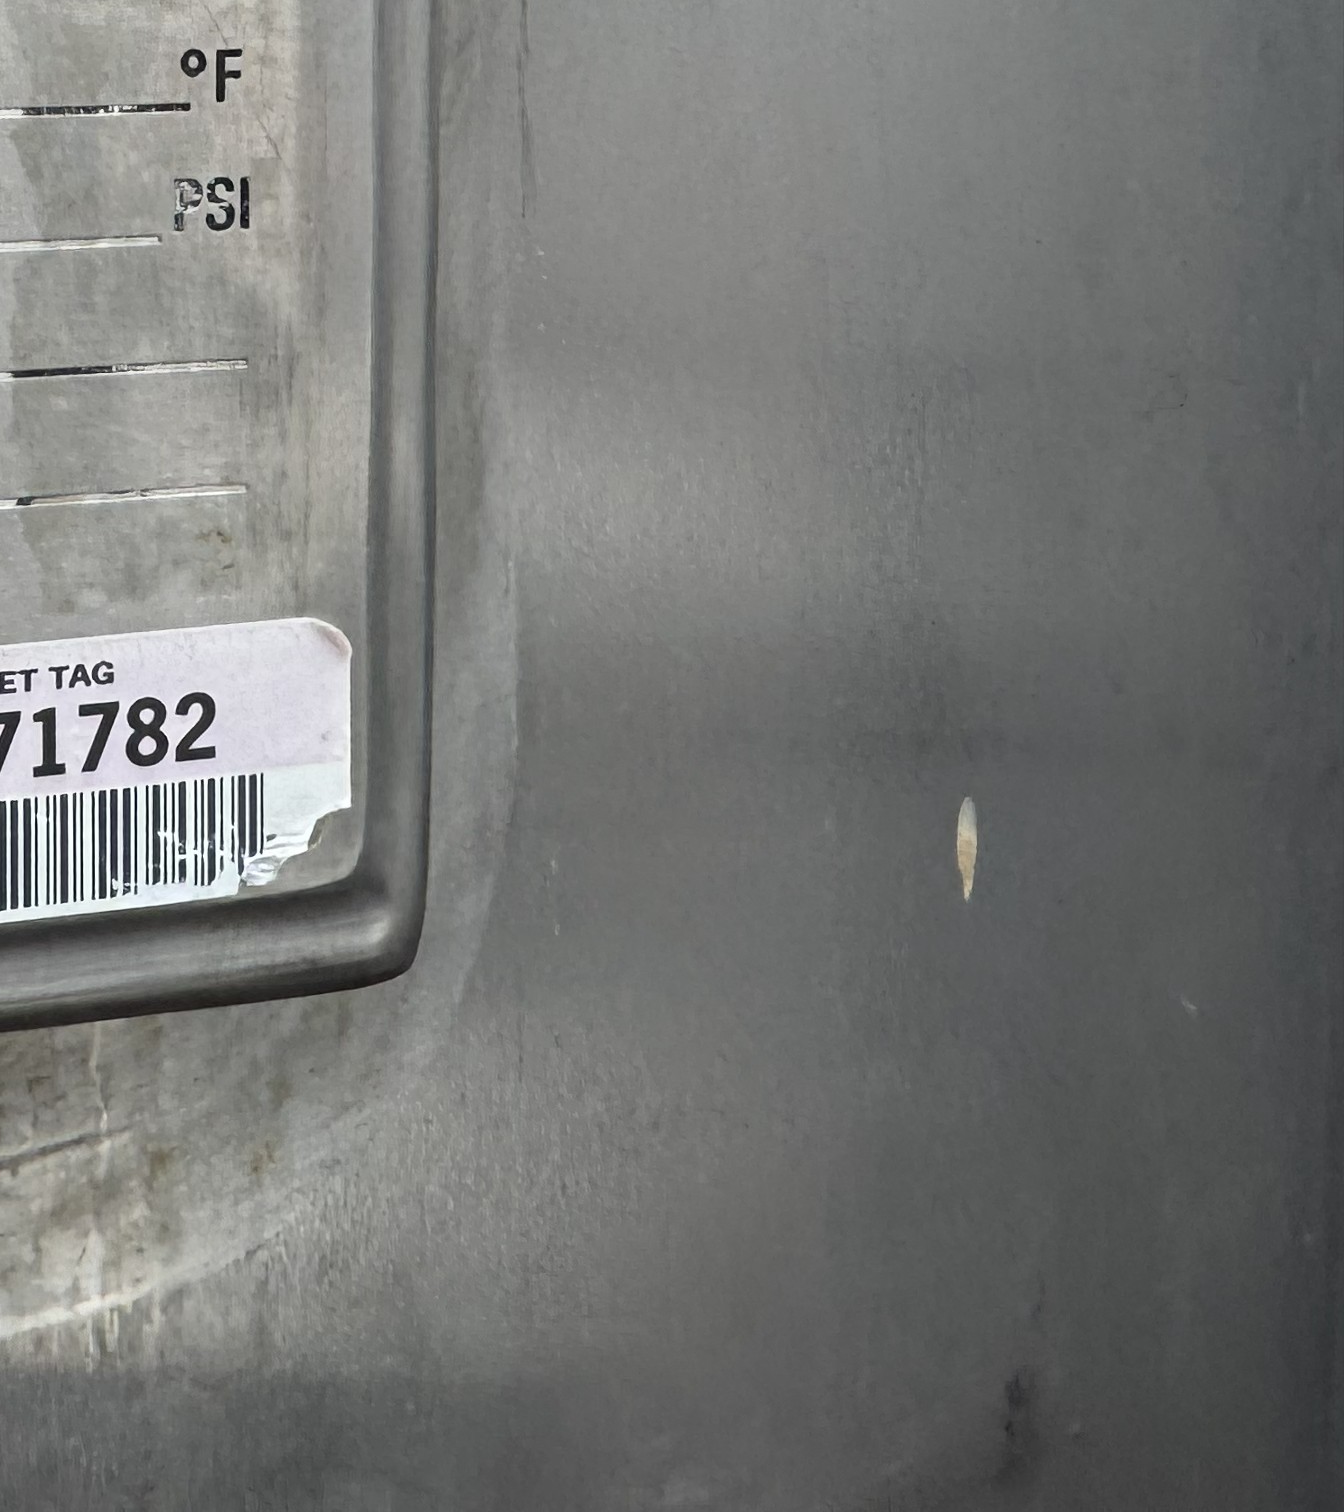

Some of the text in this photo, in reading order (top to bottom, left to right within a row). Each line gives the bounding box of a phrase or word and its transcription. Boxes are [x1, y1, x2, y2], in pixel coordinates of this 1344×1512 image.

[180, 46, 243, 103] °F
[173, 175, 252, 232] PSI
[48, 661, 115, 691] TAG
